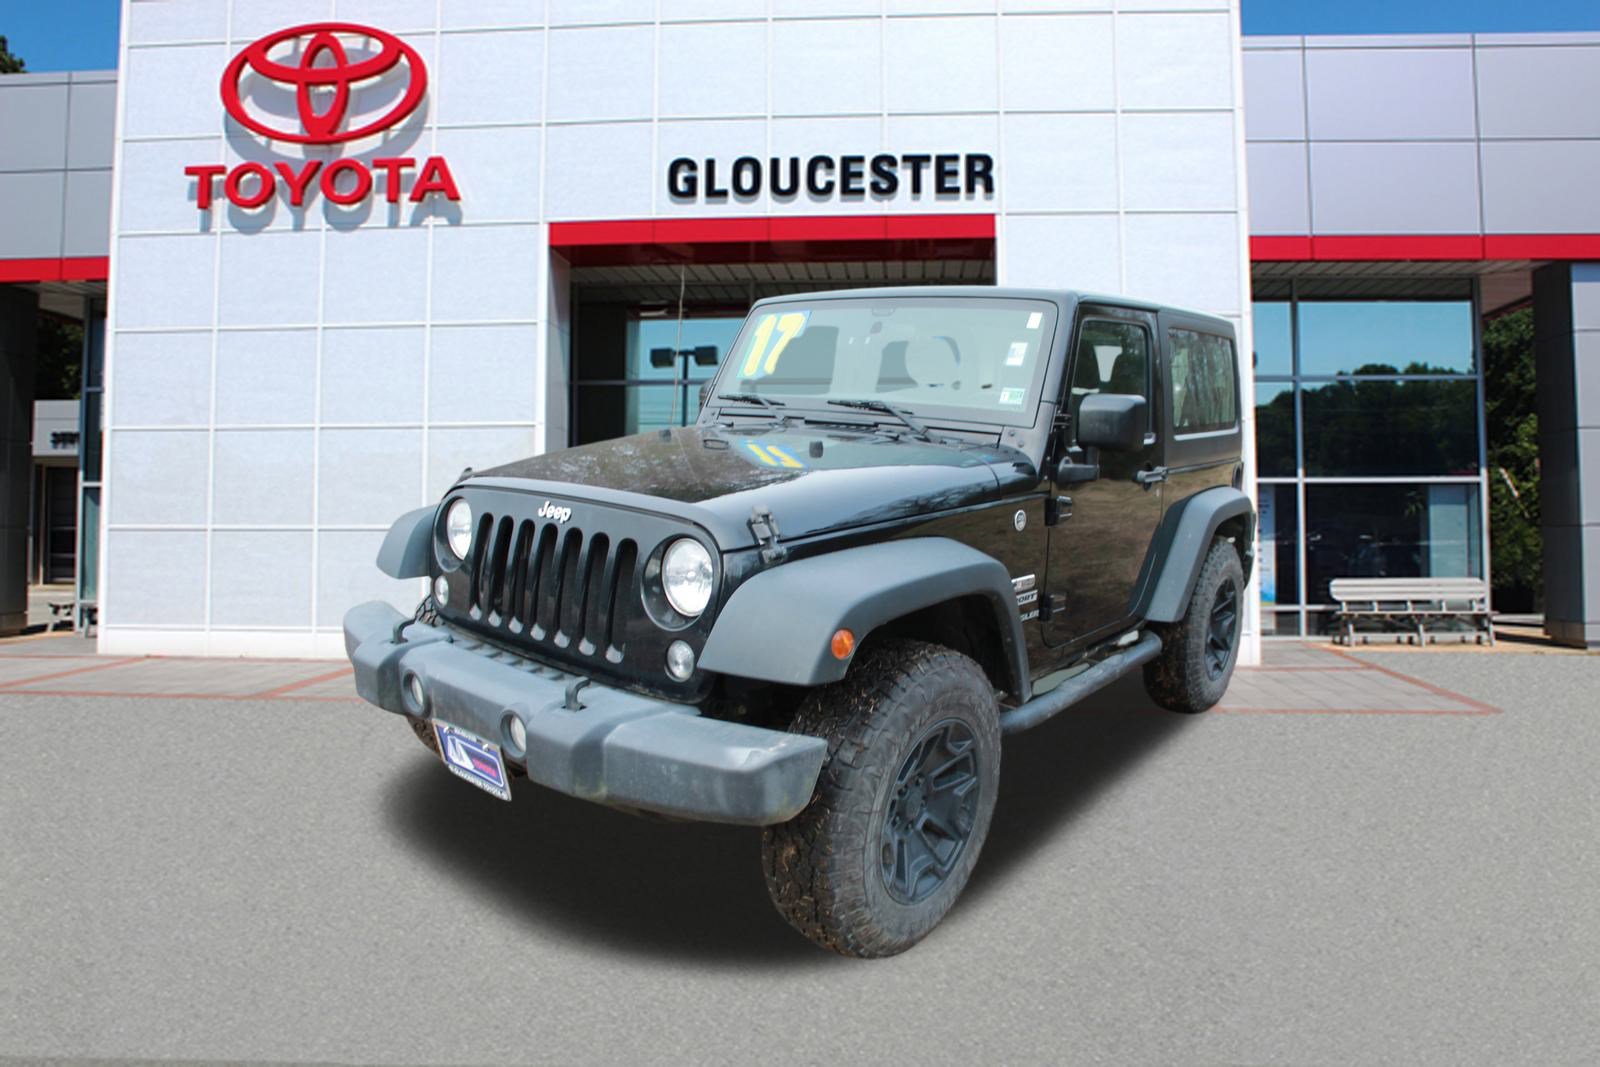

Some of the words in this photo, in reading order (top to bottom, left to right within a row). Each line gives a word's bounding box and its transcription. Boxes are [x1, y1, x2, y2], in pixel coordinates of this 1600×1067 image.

[185, 156, 460, 210] TOYOTA
[668, 154, 994, 199] GLOUCESTER
[743, 313, 806, 376] 17
[537, 500, 571, 523] Jeep
